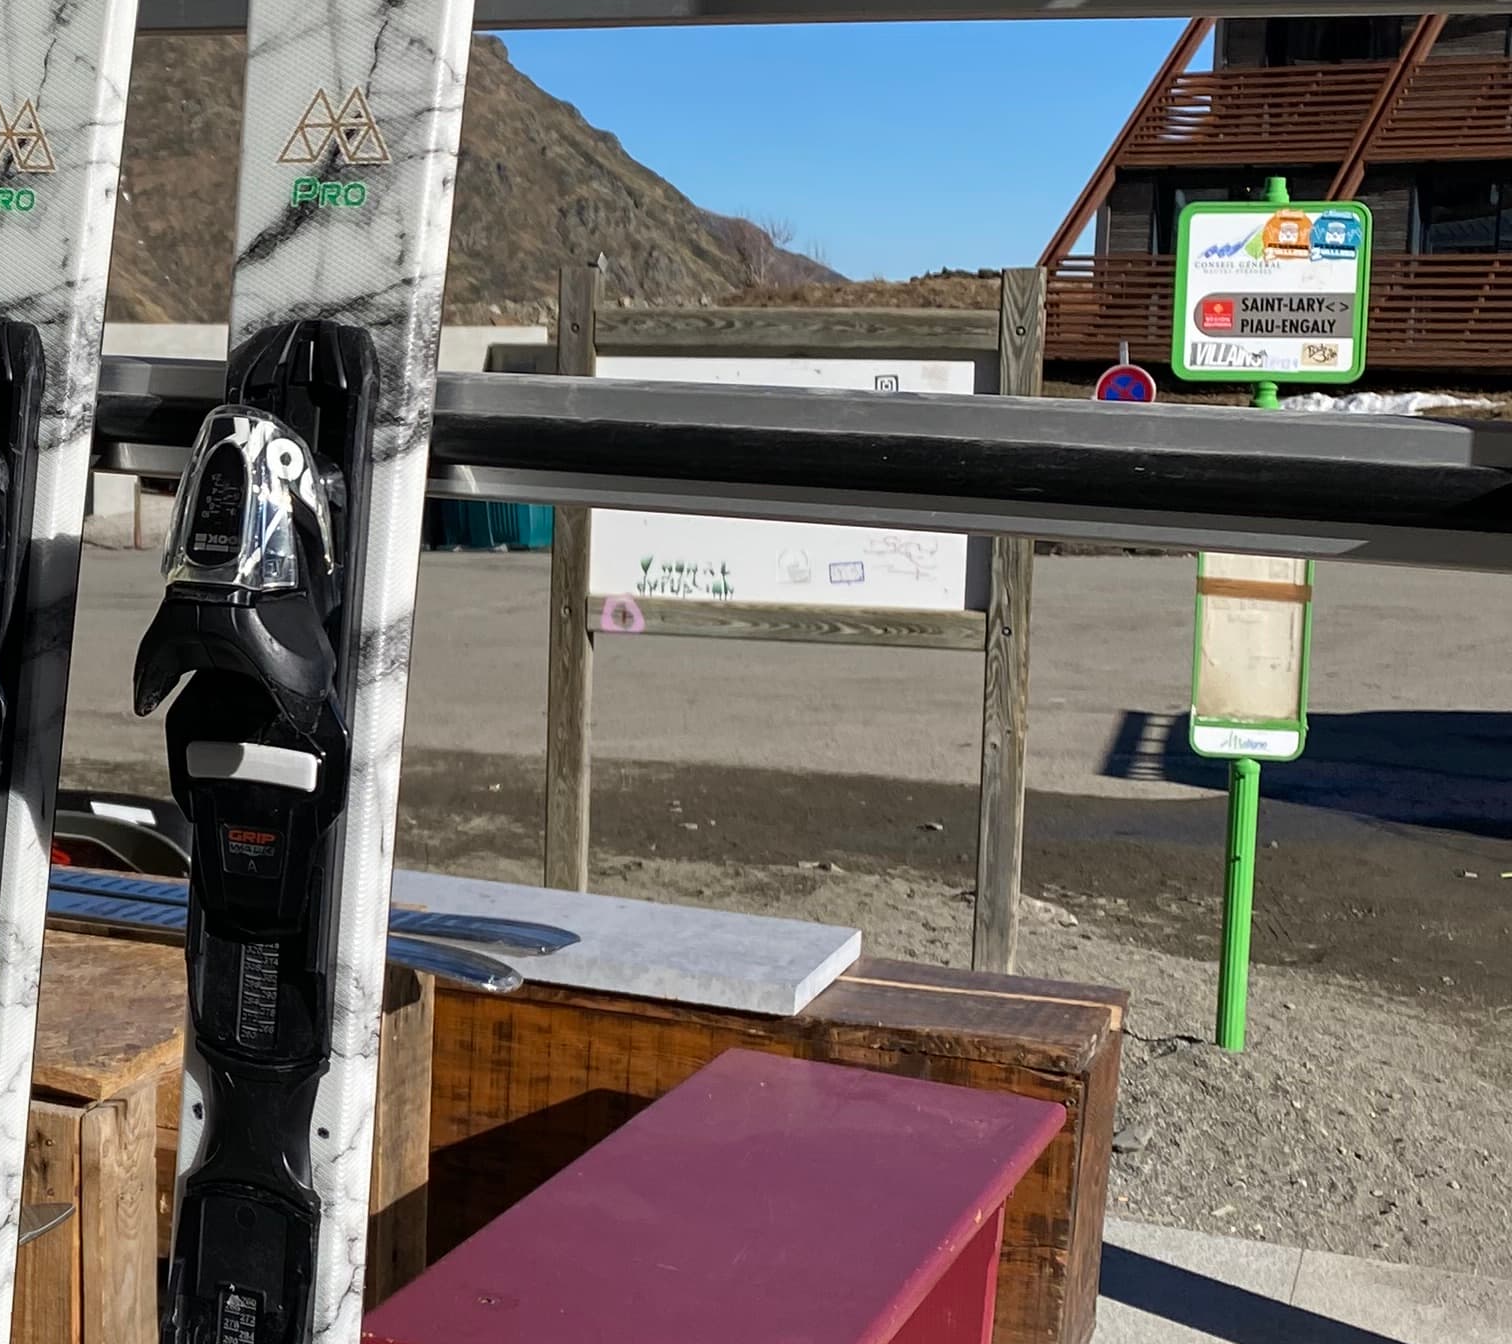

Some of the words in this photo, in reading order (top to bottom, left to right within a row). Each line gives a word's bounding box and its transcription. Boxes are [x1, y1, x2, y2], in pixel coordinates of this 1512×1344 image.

[1241, 297, 1325, 313] SAINT-LARY
[1240, 318, 1336, 334] PIAU-ENGALY
[227, 829, 276, 844] GRIP
